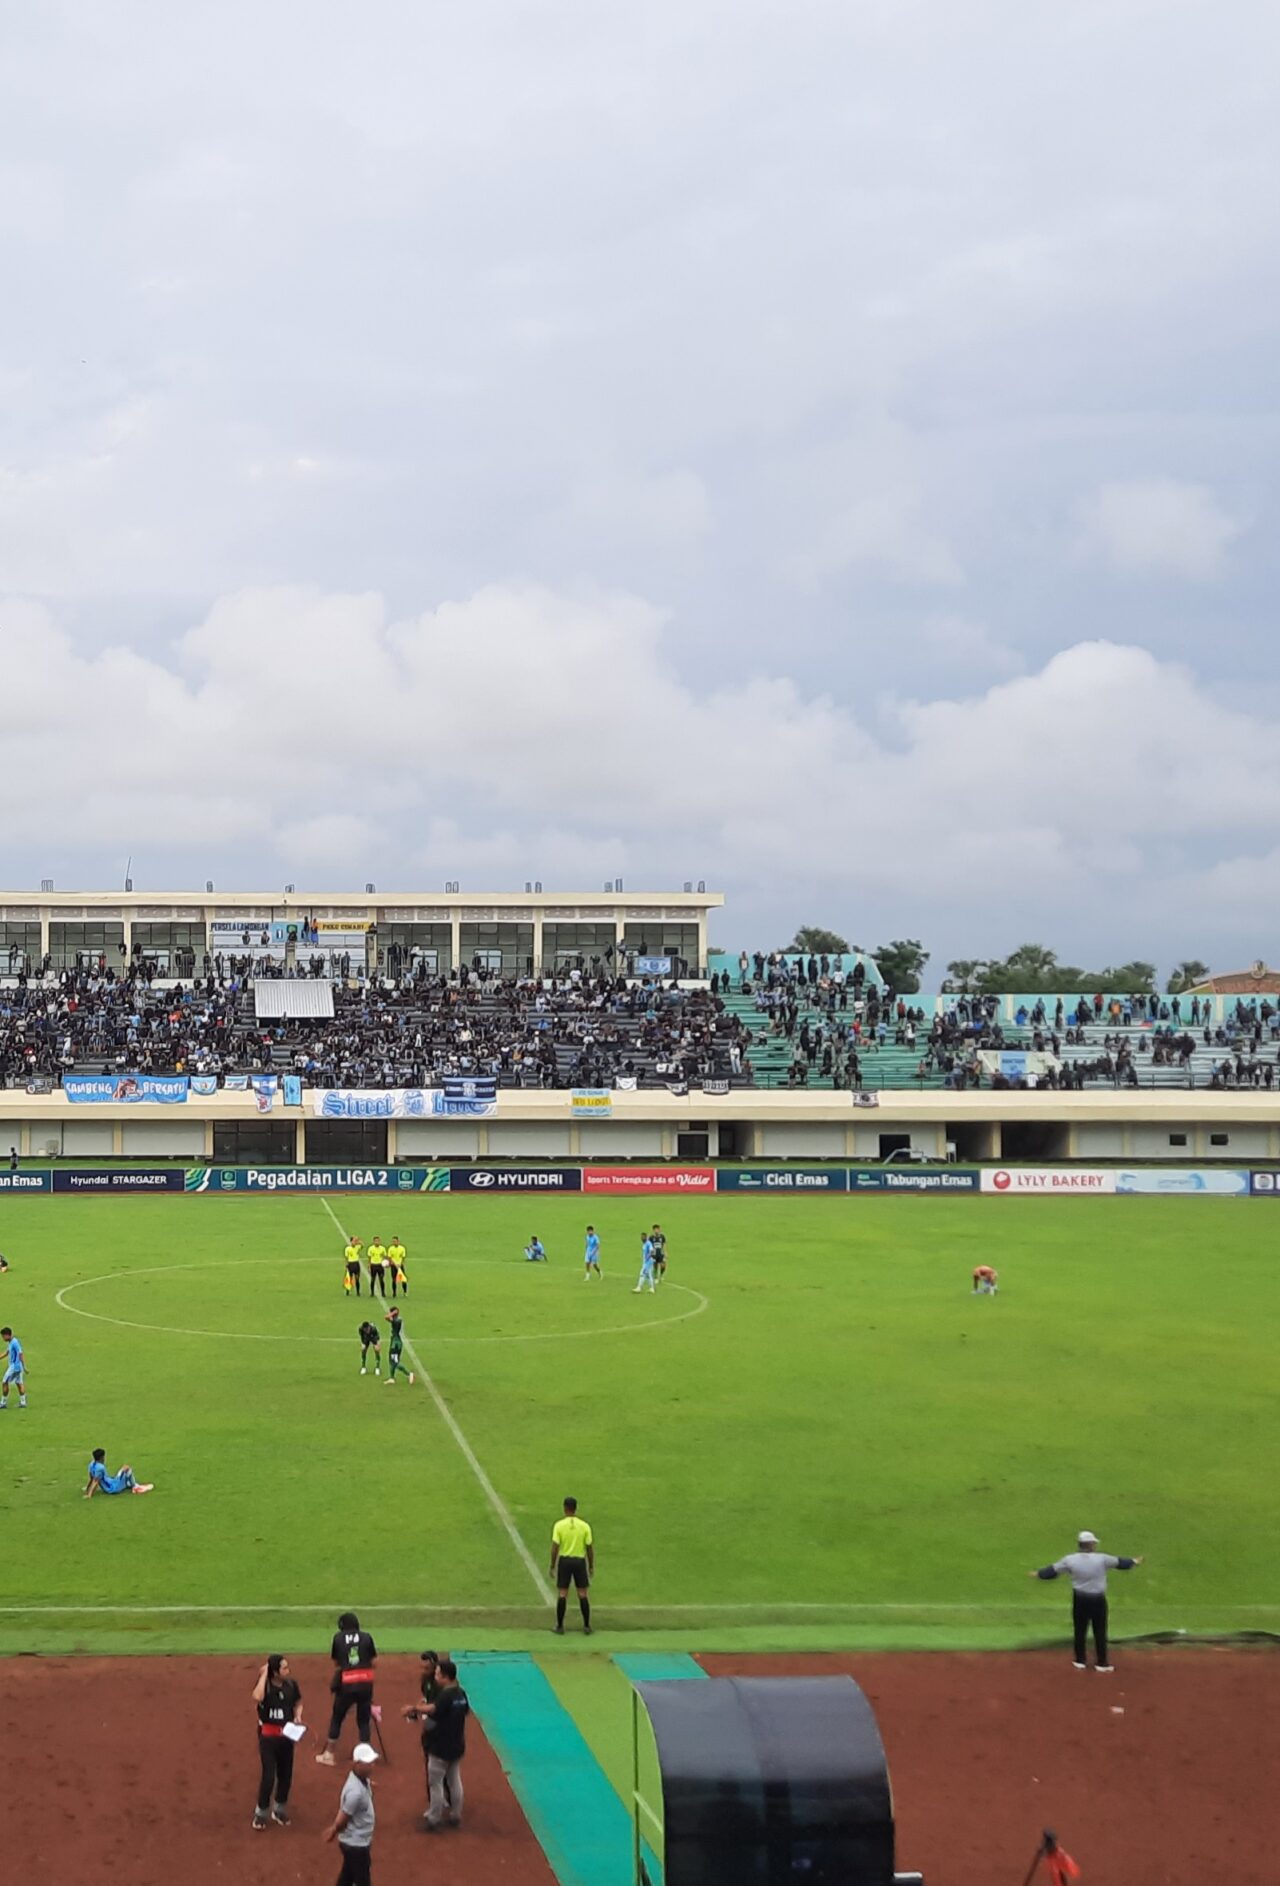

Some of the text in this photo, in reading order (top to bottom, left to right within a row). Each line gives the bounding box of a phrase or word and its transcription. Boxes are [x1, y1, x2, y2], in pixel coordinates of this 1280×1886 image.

[12, 1175, 43, 1187] Emas
[70, 1174, 167, 1186] Hyundai STARGAZER
[247, 1169, 388, 1189] Pegadaian LIGA 2
[498, 1174, 563, 1186] HYUNDAI
[676, 1173, 710, 1186] Vidio
[766, 1173, 793, 1186] Cicil
[796, 1173, 829, 1186] Emas
[885, 1173, 973, 1188] Tabungan Emas
[1018, 1175, 1105, 1187] LYLY BAKERY
